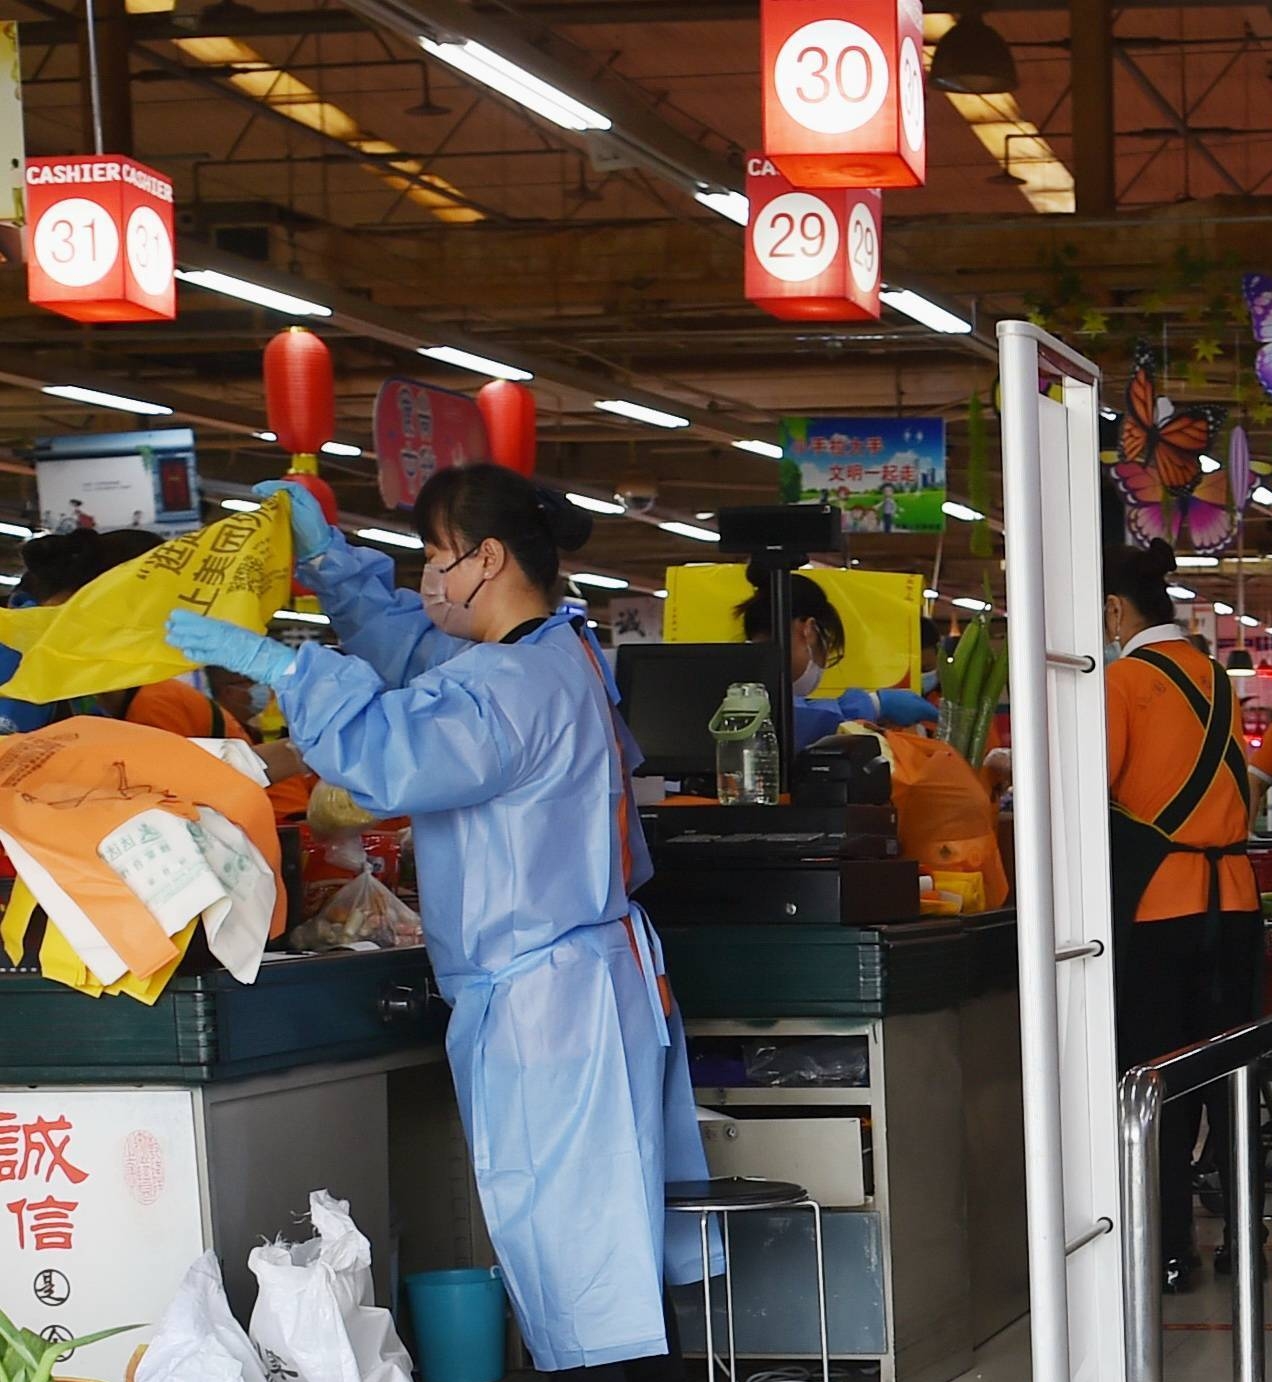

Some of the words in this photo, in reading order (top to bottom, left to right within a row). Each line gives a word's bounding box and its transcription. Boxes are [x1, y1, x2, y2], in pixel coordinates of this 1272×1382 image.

[796, 45, 872, 104] 30
[26, 163, 121, 184] CASHIER
[122, 164, 173, 202] CASHIER
[747, 158, 779, 176] CA
[51, 219, 97, 263] 31
[769, 212, 826, 258] 29
[853, 218, 874, 272] 29
[829, 464, 918, 482] 文明一起走
